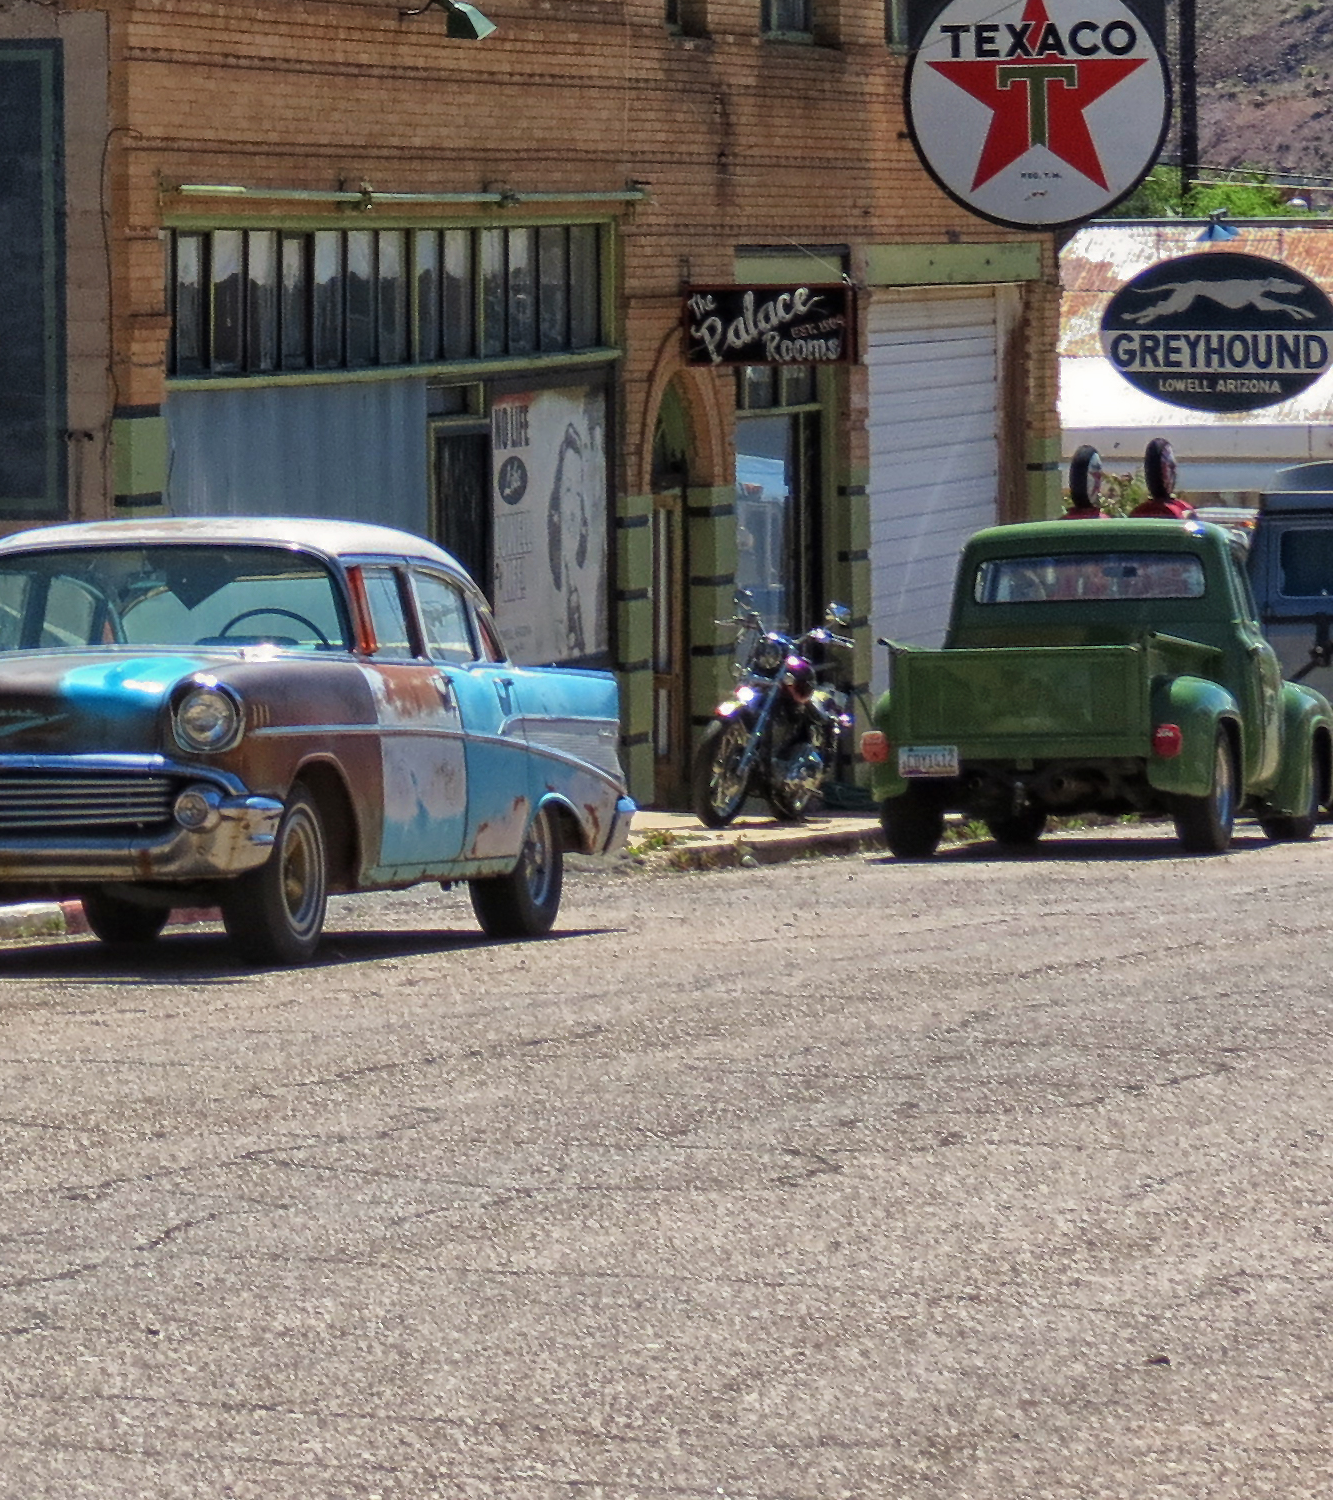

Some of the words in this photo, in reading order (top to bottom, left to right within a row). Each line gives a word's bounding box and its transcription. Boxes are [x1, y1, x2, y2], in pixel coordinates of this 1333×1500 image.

[940, 20, 1137, 58] TEXACO
[689, 287, 825, 366] Palace
[762, 331, 841, 363] Rooms
[1110, 333, 1328, 369] GREYHOUND
[1159, 379, 1212, 392] LOWELL
[1215, 379, 1282, 393] ARIZONA
